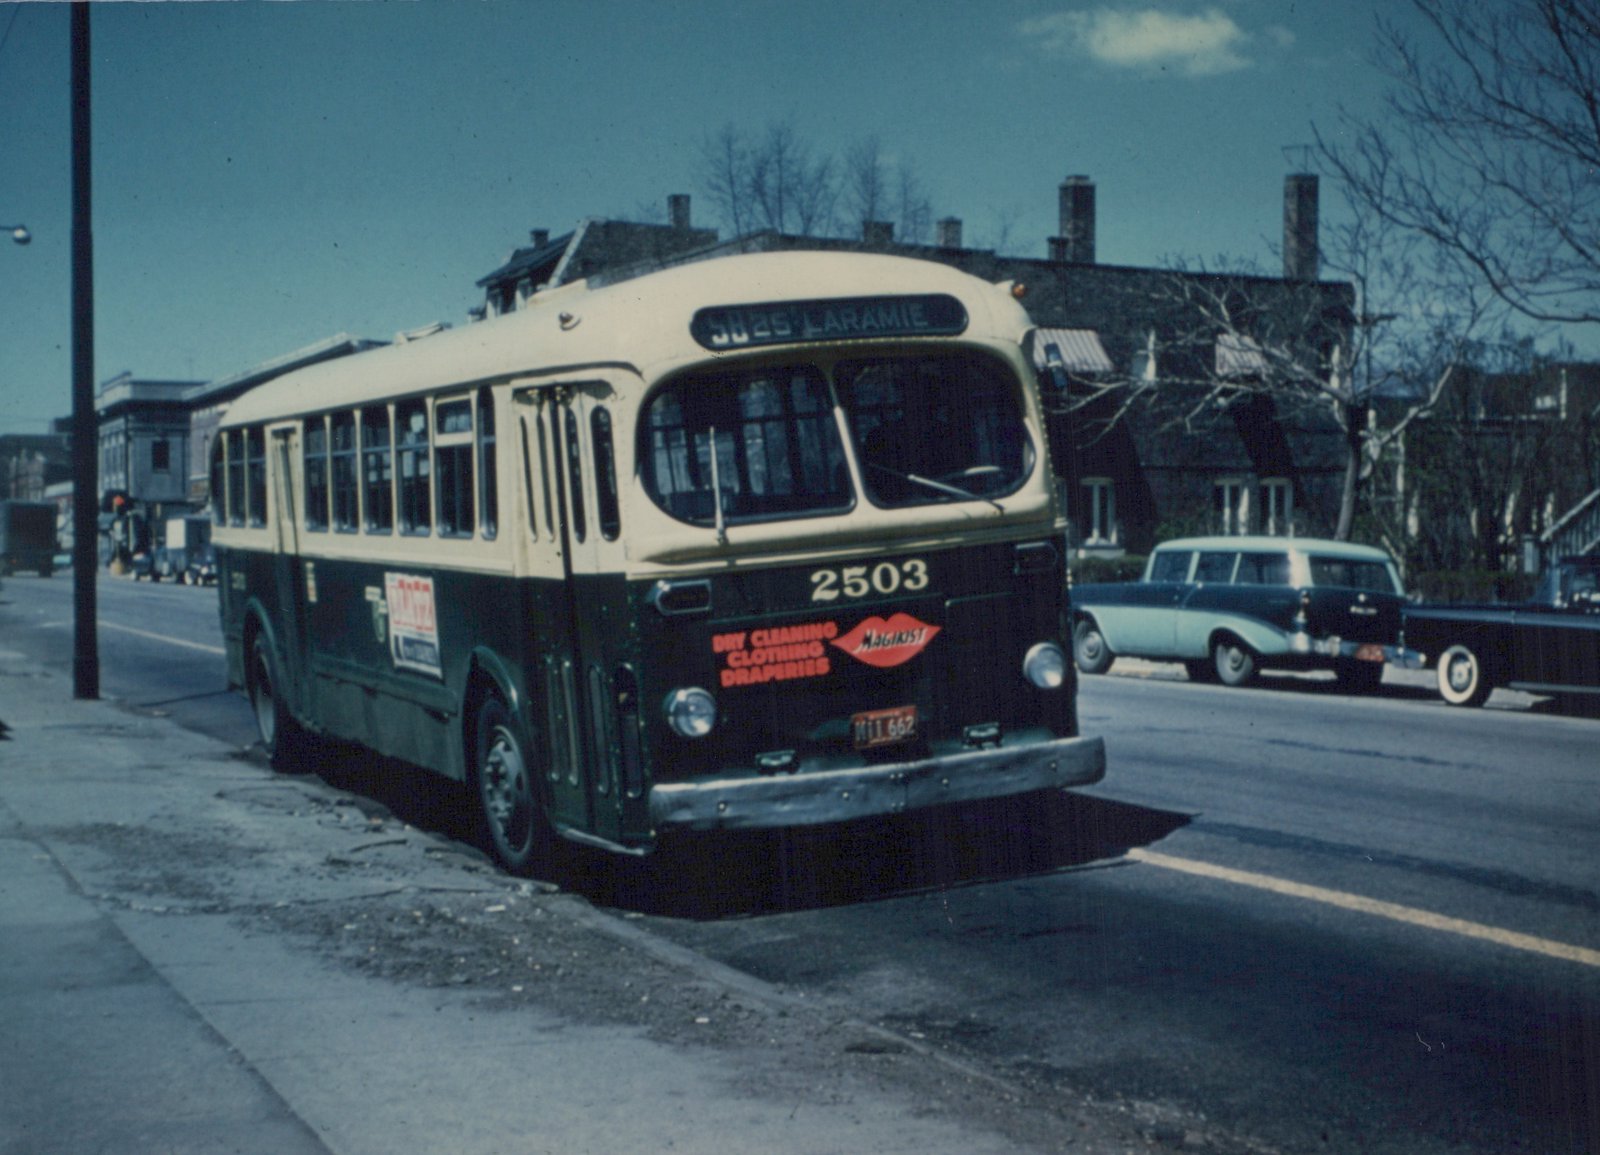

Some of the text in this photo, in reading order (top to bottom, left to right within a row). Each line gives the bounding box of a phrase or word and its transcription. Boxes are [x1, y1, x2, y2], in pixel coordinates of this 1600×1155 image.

[803, 303, 928, 336] LARAMIE
[810, 559, 929, 601] 2503
[712, 620, 838, 653] DRY CLEANING
[727, 640, 824, 667] CLOTHING
[720, 656, 830, 688] DRAPERIES
[888, 715, 915, 736] 662
